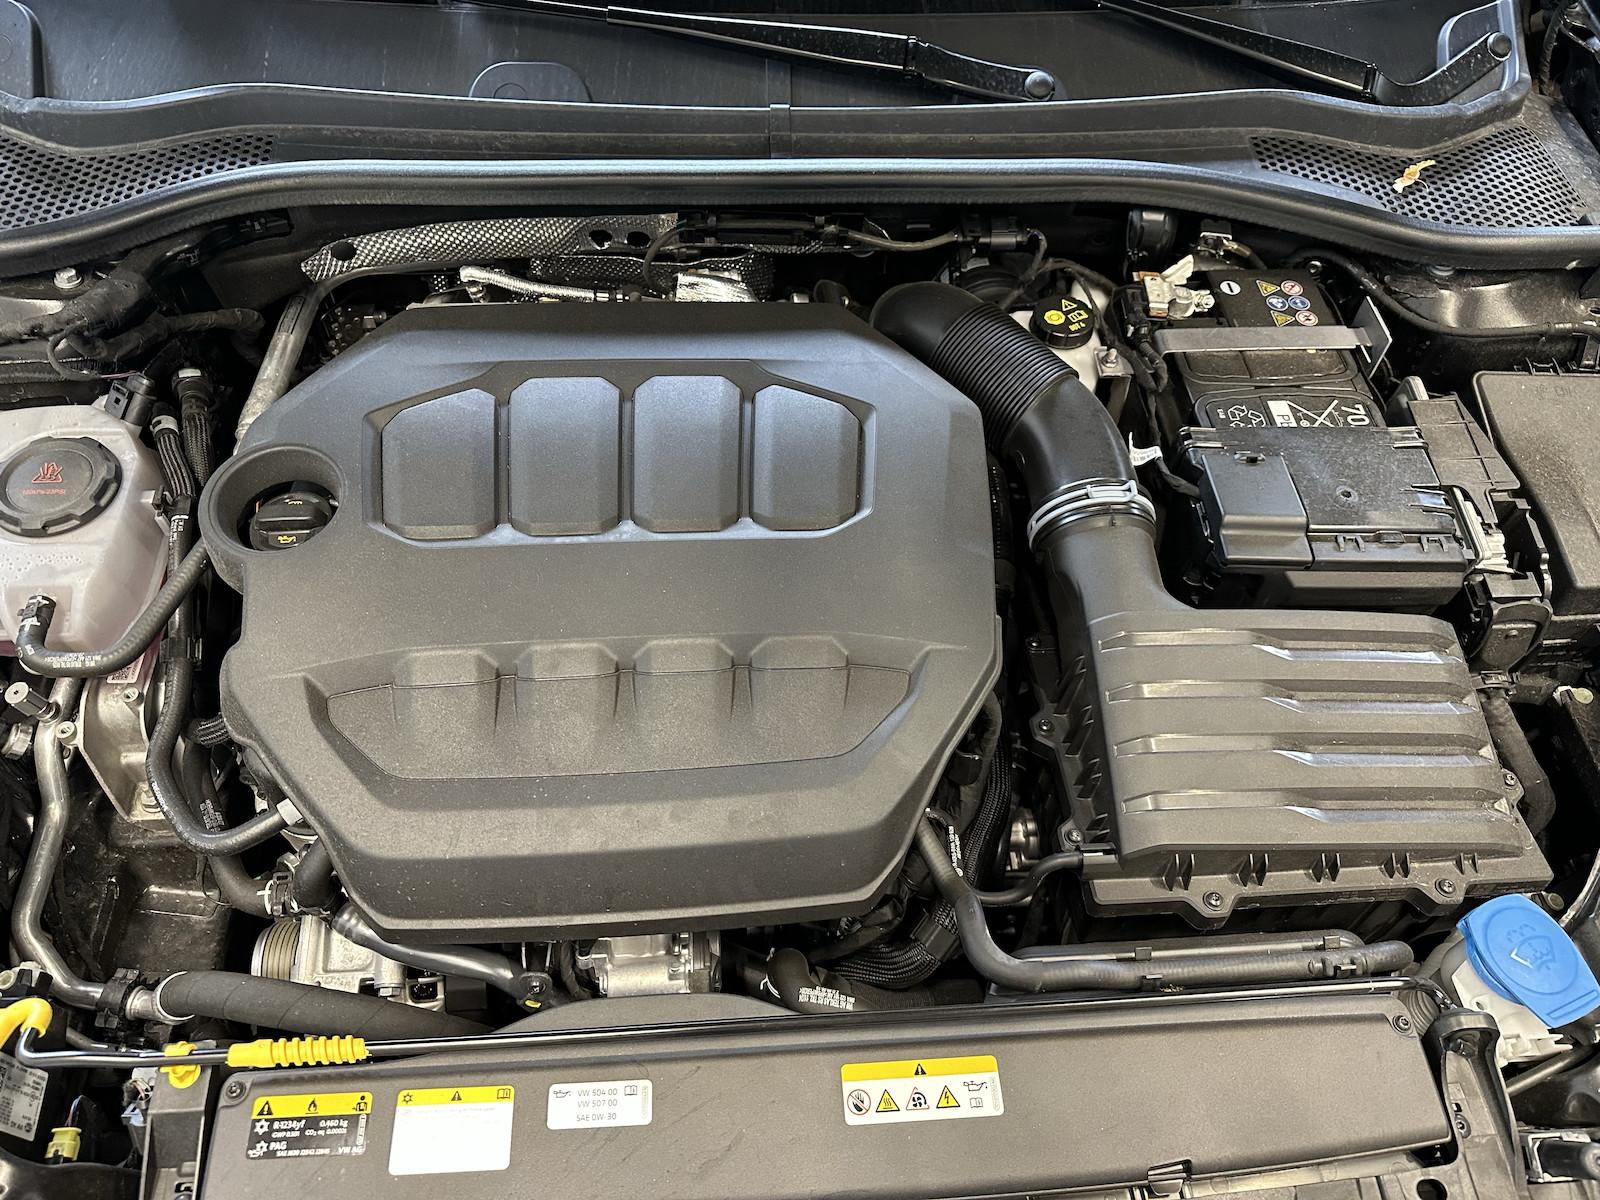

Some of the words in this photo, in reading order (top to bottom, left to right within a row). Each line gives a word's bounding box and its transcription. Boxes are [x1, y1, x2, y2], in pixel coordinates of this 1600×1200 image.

[592, 1088, 606, 1097] 504
[607, 1088, 618, 1096] 00
[578, 1100, 590, 1108] VW
[592, 1099, 606, 1108] 507
[607, 1098, 618, 1107] 00
[576, 1114, 591, 1122] SAE
[591, 1112, 617, 1121] 0W-30
[274, 1120, 306, 1130] R-1234yf
[340, 1120, 349, 1128] kg
[269, 1142, 287, 1151] PAG
[351, 1146, 362, 1154] AG
